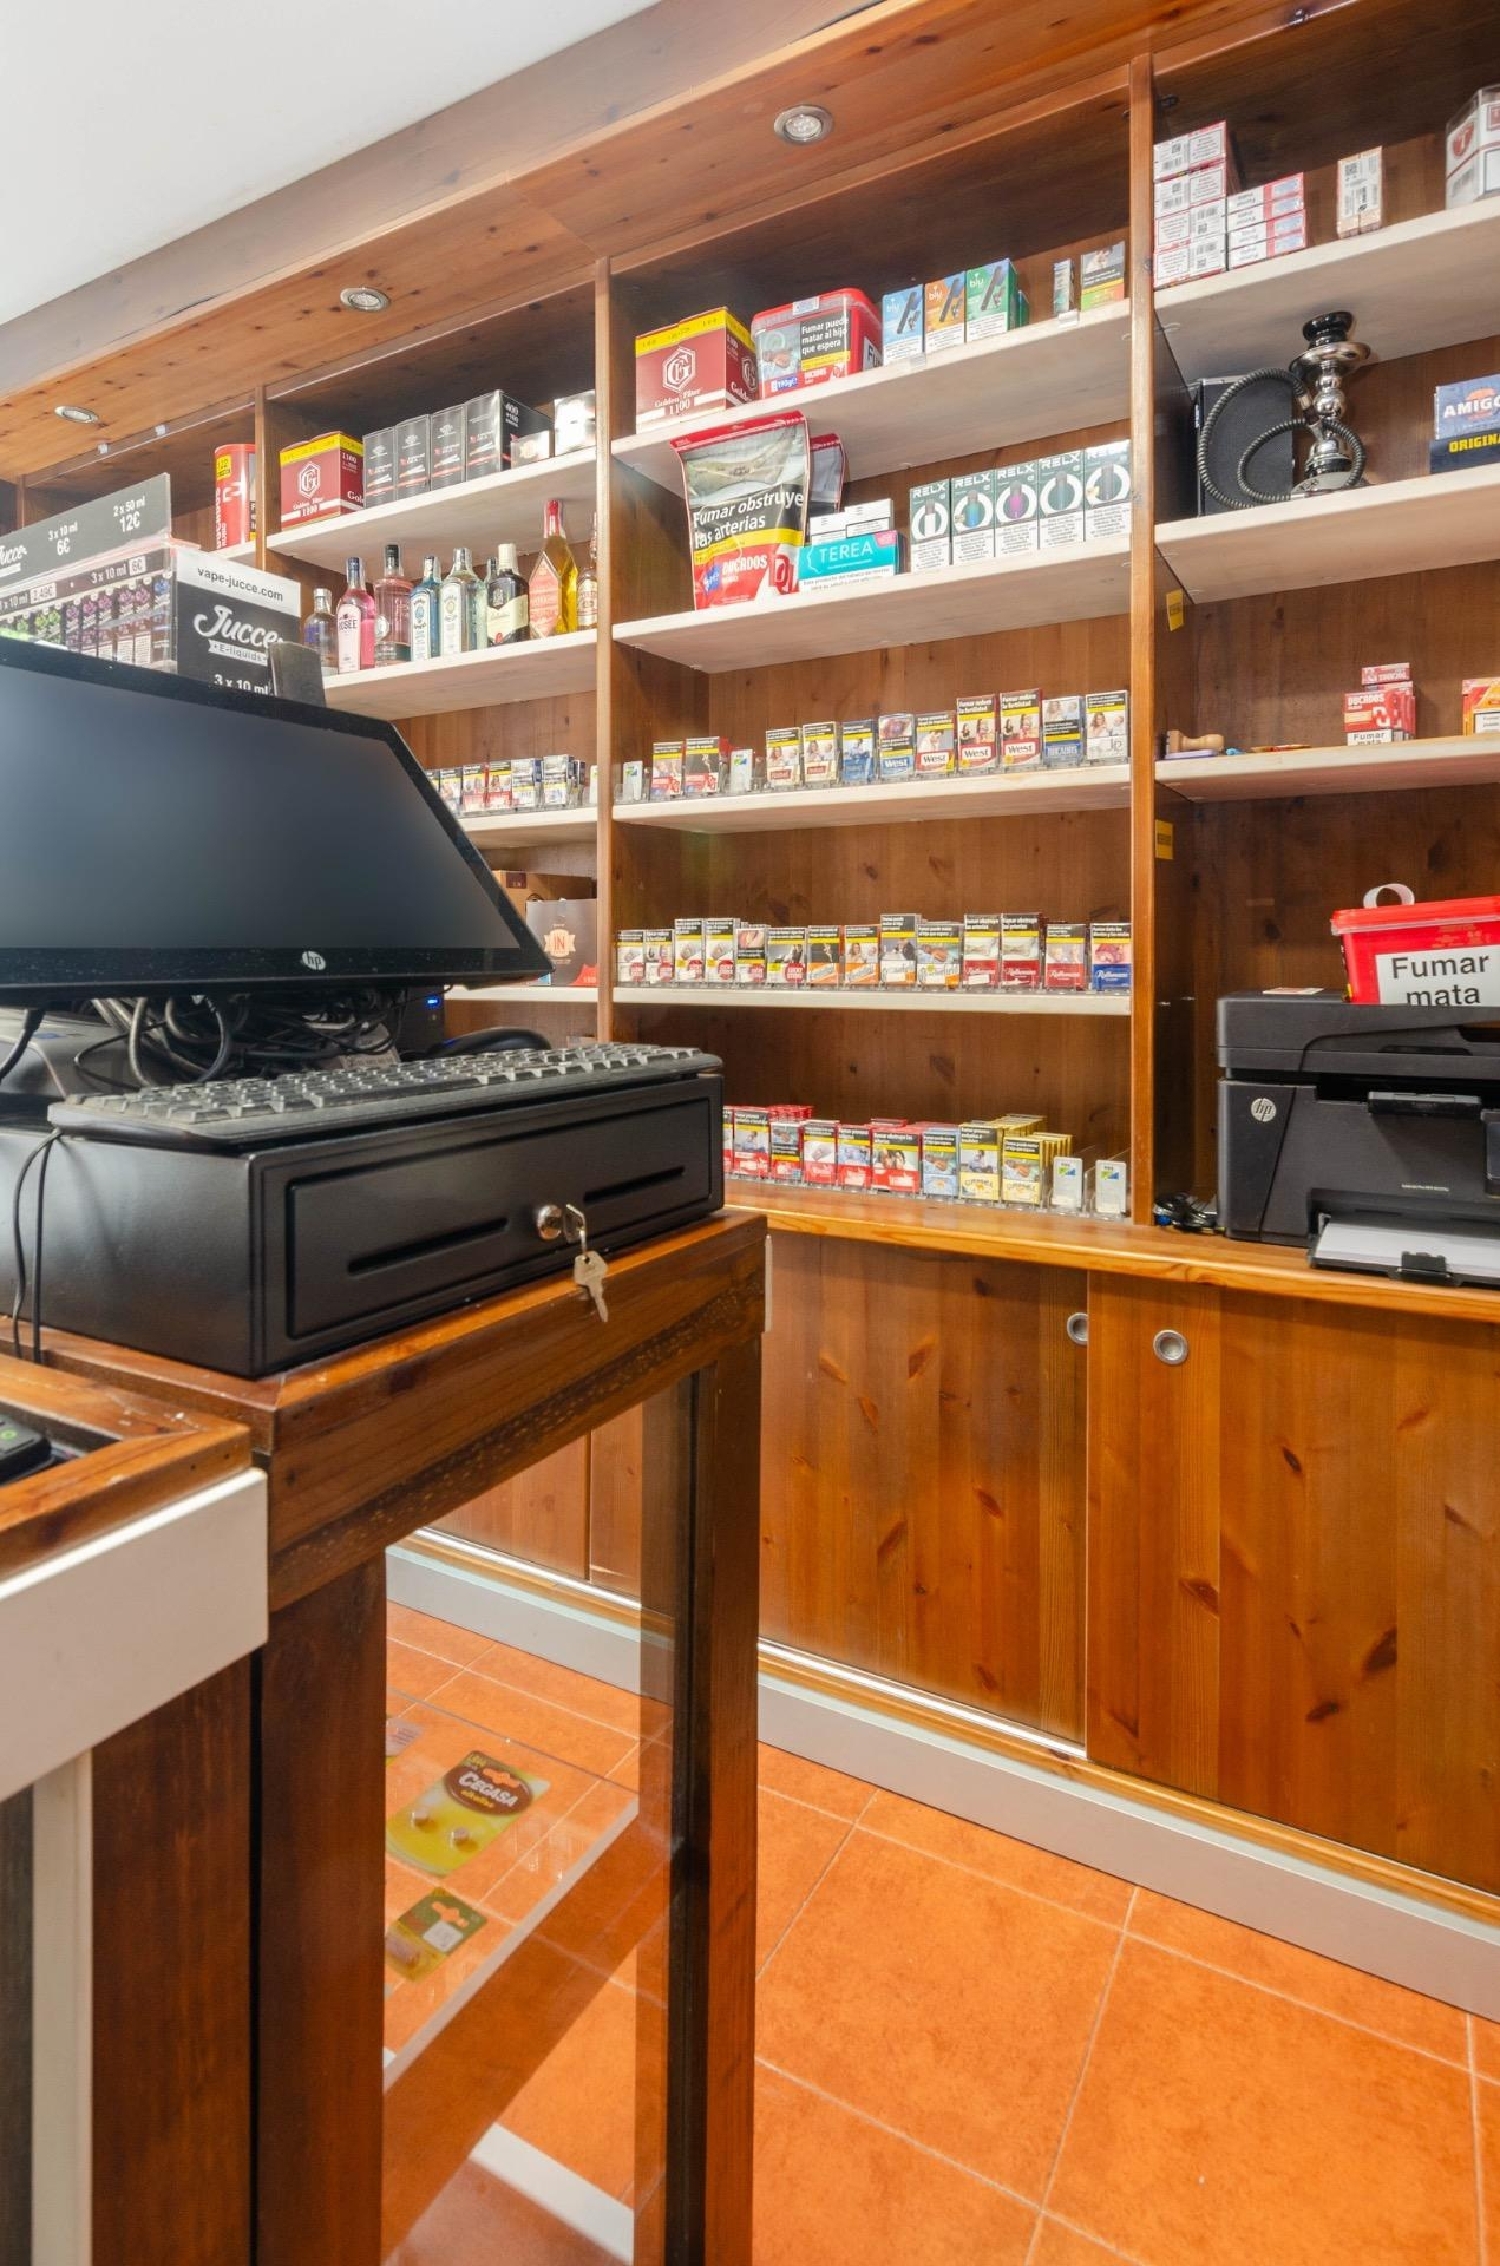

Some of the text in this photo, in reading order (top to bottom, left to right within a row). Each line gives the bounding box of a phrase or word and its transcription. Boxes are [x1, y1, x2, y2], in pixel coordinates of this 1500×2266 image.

[803, 322, 825, 334] Fumar
[803, 333, 824, 345] matar
[824, 330, 832, 340] al
[803, 340, 841, 356] que espera
[1449, 433, 1500, 453] ORIGIN
[1041, 455, 1080, 469] RELX
[955, 473, 991, 489] RELX
[998, 465, 1035, 479] RELX
[912, 483, 946, 498] RELX
[113, 505, 119, 517] 2
[125, 500, 135, 511] 50
[136, 496, 146, 508] ml
[693, 491, 804, 528] Fumar obstruye
[48, 531, 54, 541] 3
[60, 525, 68, 536] 10
[69, 521, 78, 533] ml
[119, 514, 140, 533] 12€
[694, 514, 766, 548] las arterias
[57, 538, 71, 556] 6€
[819, 541, 874, 563] TEREA
[91, 573, 98, 584] 3
[105, 568, 116, 580] 10
[117, 564, 127, 577] ml
[197, 567, 284, 602] vape-jucce.com
[193, 604, 284, 649] Jucce
[214, 674, 223, 686] 3
[236, 679, 251, 691] 10
[1353, 733, 1384, 741] Fumar
[964, 747, 989, 758] West
[306, 952, 323, 971] hp
[1392, 954, 1490, 979] Fumar
[1406, 983, 1481, 1007] mata
[1254, 1098, 1274, 1122] hp
[459, 1771, 518, 1807] CEGASA
